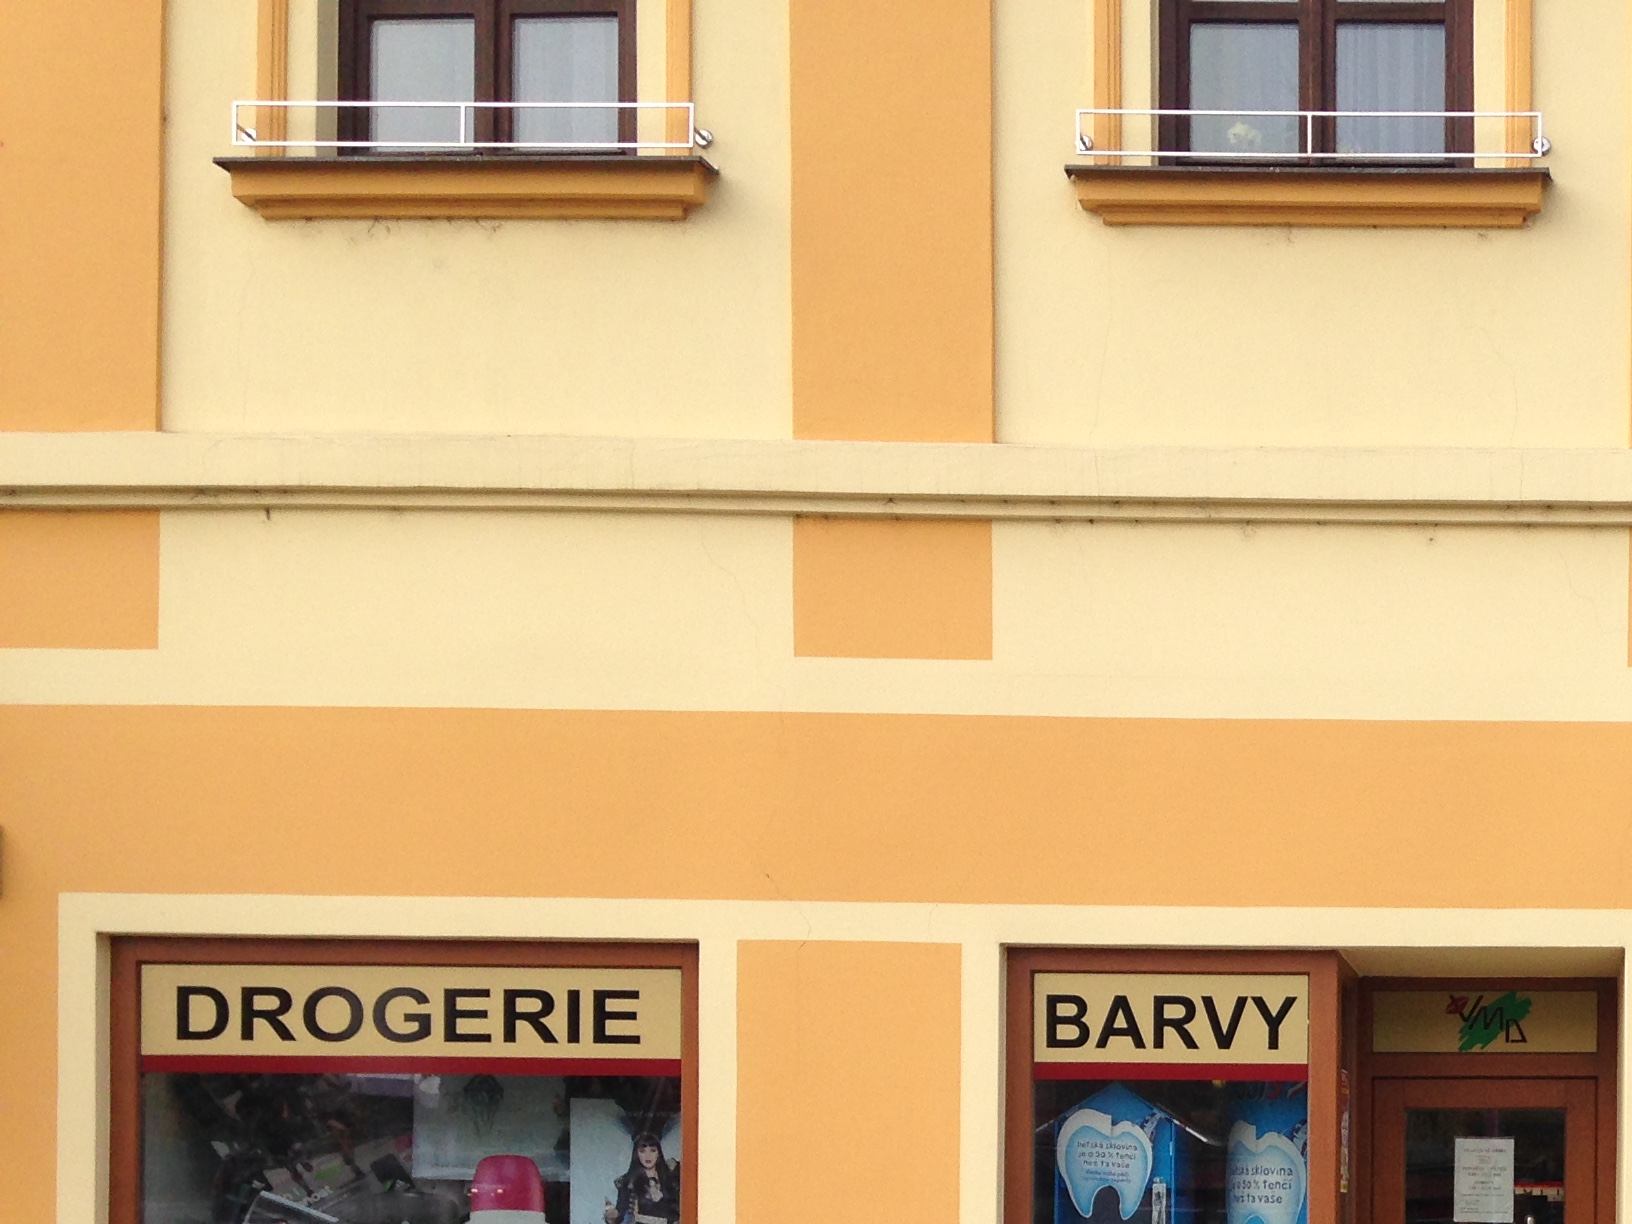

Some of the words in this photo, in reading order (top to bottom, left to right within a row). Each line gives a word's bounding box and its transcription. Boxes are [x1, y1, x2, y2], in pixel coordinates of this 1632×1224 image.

[176, 985, 641, 1045] DROGERIE
[1046, 994, 1298, 1050] BARVY
[1258, 1191, 1283, 1204] vaše
